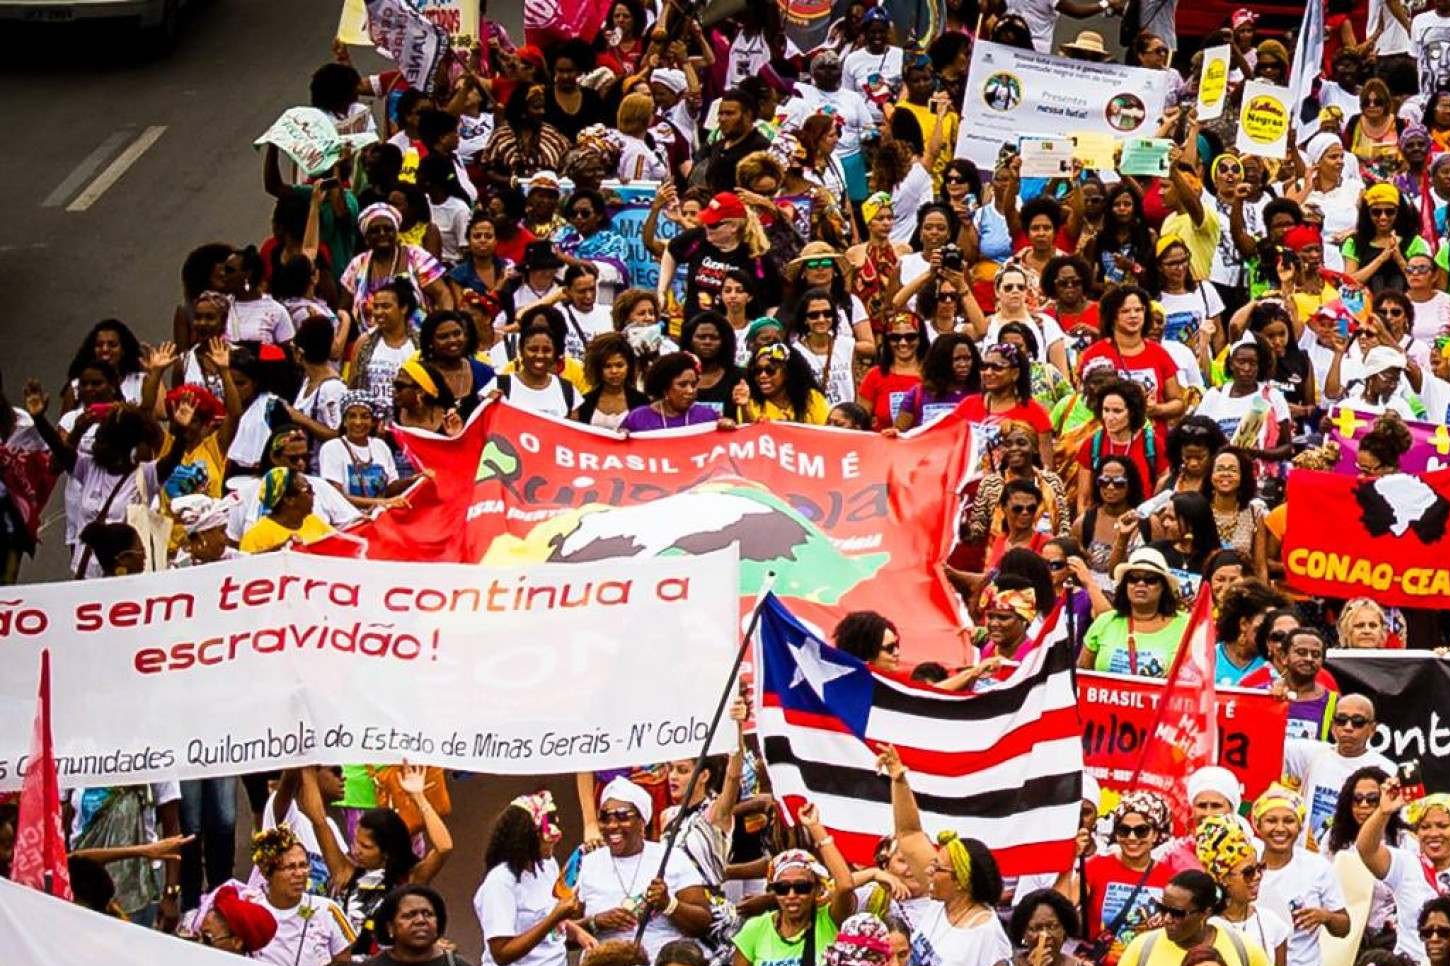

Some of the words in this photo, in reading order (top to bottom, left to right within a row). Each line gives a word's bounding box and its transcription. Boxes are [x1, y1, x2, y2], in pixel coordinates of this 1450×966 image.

[519, 432, 541, 454] O
[555, 446, 679, 474] BRASIL
[691, 434, 826, 480] TAMBÉM
[842, 450, 861, 480] É
[76, 591, 195, 632] sem
[219, 574, 360, 612] terra
[384, 575, 632, 615] continua
[656, 577, 690, 602] a
[134, 616, 441, 675] escravidão!
[1087, 687, 1144, 709] BRASIL
[1225, 697, 1236, 718] É
[16, 747, 174, 777] Cmunidades
[188, 721, 316, 766] Quilombola
[325, 723, 353, 749] do
[361, 727, 435, 758] Estado
[441, 729, 466, 757] de
[472, 731, 532, 760] Minas
[540, 727, 611, 757] Gerais
